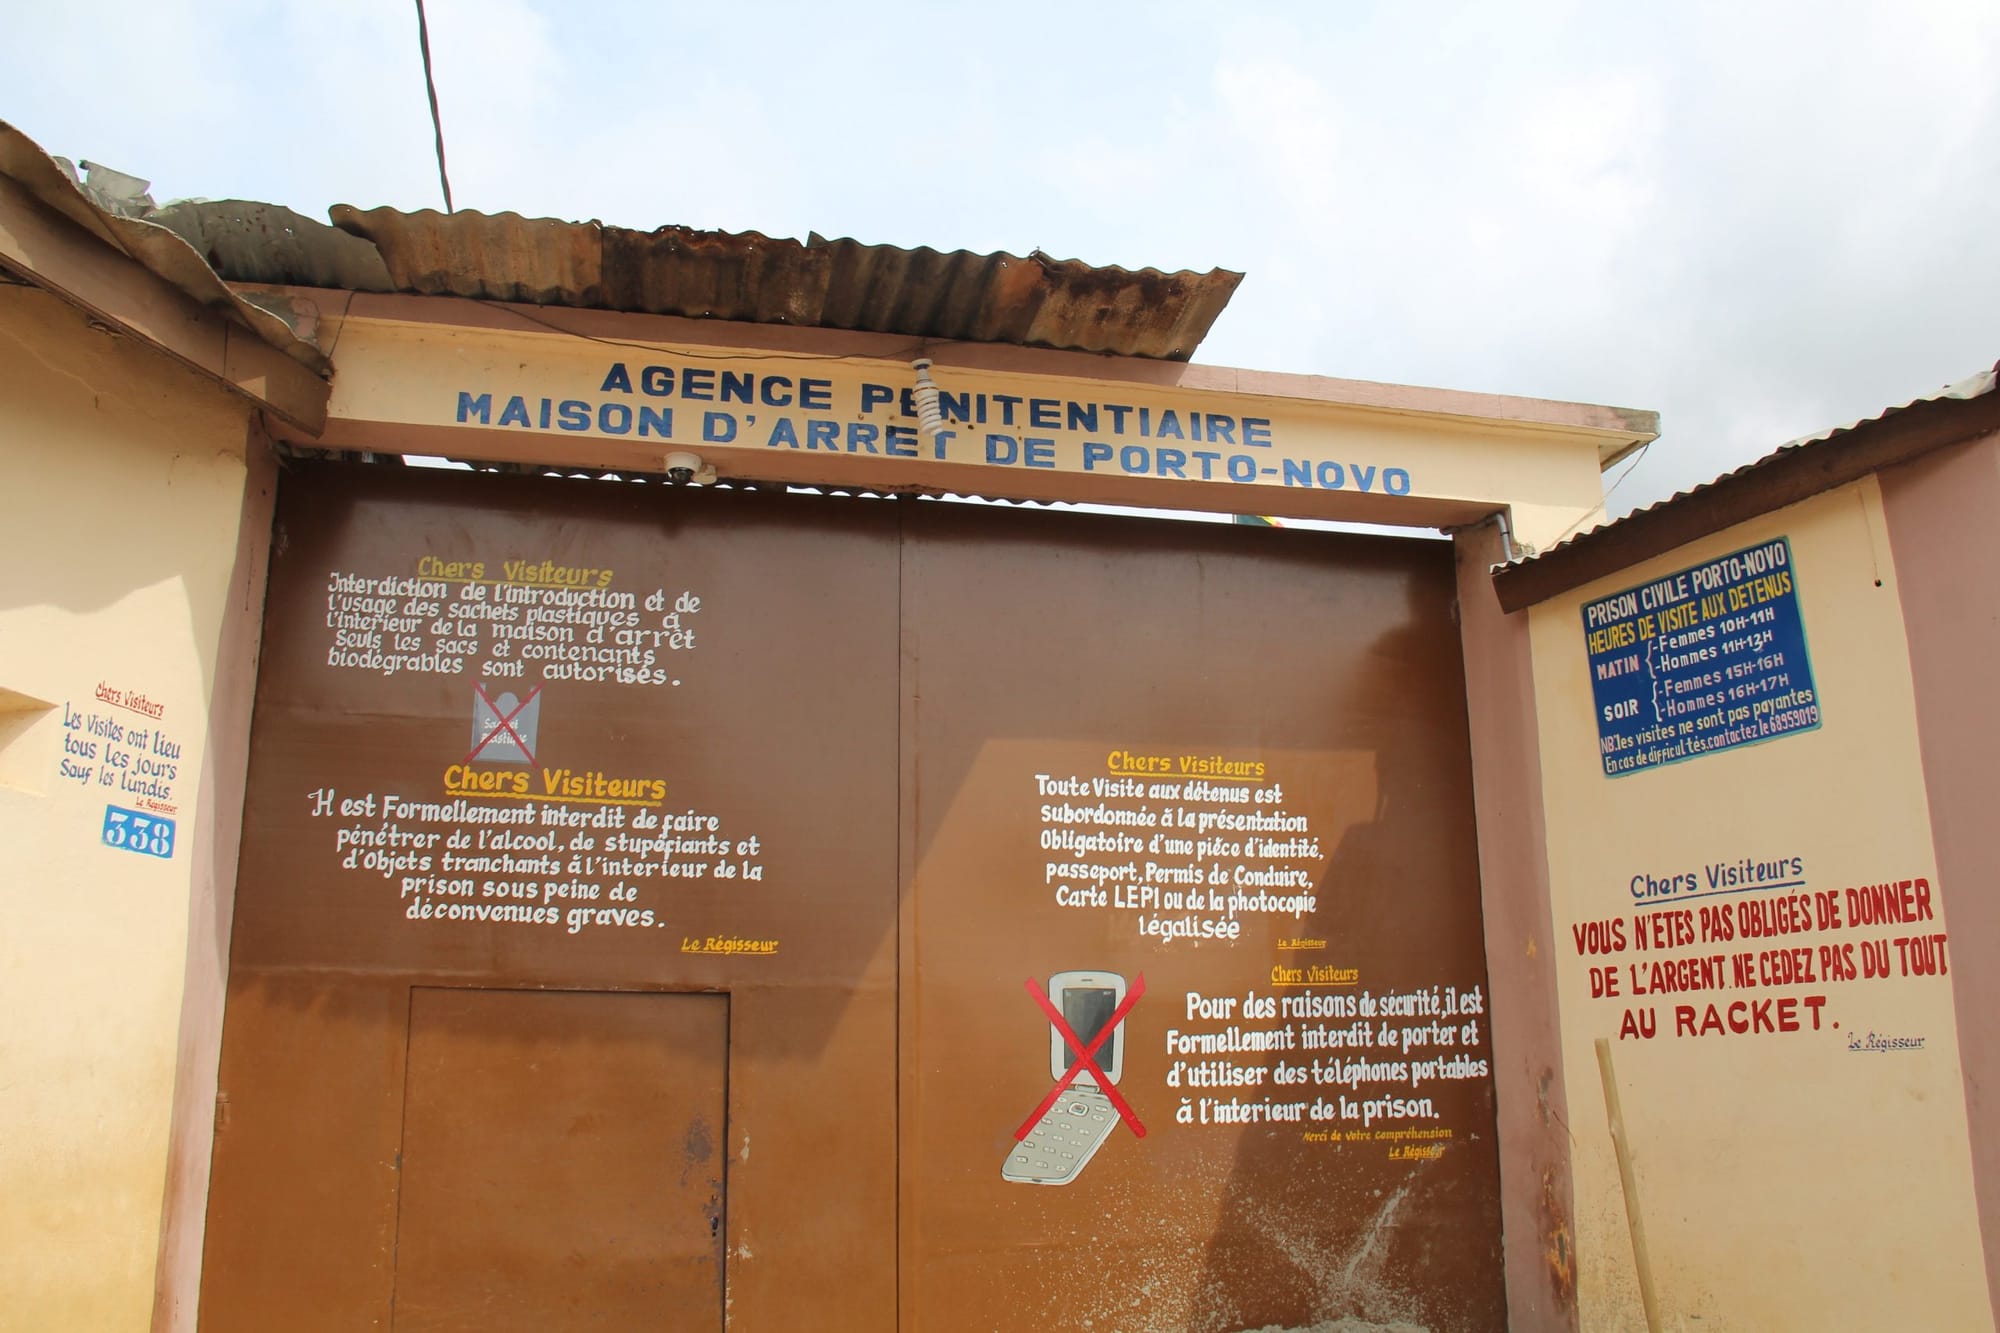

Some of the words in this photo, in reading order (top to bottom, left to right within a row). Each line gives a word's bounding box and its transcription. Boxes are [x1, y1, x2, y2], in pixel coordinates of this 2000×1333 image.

[601, 363, 832, 410] AGENCE
[861, 384, 1272, 448] PENITENTIAIRE
[457, 391, 673, 439] MAISON
[703, 411, 956, 460] D'ARRET
[985, 433, 1056, 468] DE
[1083, 442, 1411, 497] PORTO-NOVO
[418, 556, 485, 580] Chers
[503, 559, 614, 587] Visiteurs
[1587, 593, 1638, 628] PRISON
[1641, 575, 1689, 610] CIVILE
[1691, 542, 1786, 594] PORTO-NOVO
[328, 572, 447, 599] Interdiction
[461, 581, 486, 601] de
[494, 583, 635, 610] l'introduction
[644, 589, 665, 612] et
[675, 591, 701, 613] de
[328, 593, 396, 618] l'usage
[403, 600, 440, 617] des
[448, 601, 519, 621] sachets
[526, 606, 640, 628] plastiques
[1588, 622, 1637, 655] HEURES
[1638, 617, 1656, 641] DE
[1657, 601, 1698, 635] VISITE
[1702, 594, 1727, 621] AUX
[1729, 571, 1792, 612] DETENUS
[1719, 607, 1775, 634] 10H-11H
[327, 611, 422, 633] l'interieur
[430, 619, 453, 635] de
[457, 620, 478, 637] la
[492, 622, 574, 643] maison
[586, 625, 697, 650] d'arrêt
[336, 629, 382, 649] Seuls
[394, 634, 421, 651] les
[435, 638, 478, 655] sacs
[492, 639, 511, 657] et
[521, 642, 656, 666] contenants
[481, 658, 525, 677] sont
[1597, 654, 1640, 680] MATIN
[1725, 652, 1784, 680] 15H-16H
[1728, 673, 1789, 700] 16H-17H
[1604, 698, 1639, 721] SOIR
[1636, 723, 1676, 745] visites
[1678, 720, 1694, 735] ne
[1696, 707, 1726, 730] sont
[1728, 705, 1750, 727] pas
[1753, 688, 1813, 721] payantes
[1769, 705, 1819, 733] 68959019
[63, 700, 82, 730] Les
[127, 728, 149, 750] ont
[153, 730, 182, 760] lieu
[64, 732, 97, 759] tous
[105, 743, 130, 769] les
[131, 753, 178, 780] jours
[1107, 751, 1172, 771] Chers
[1179, 755, 1265, 776] Visiteurs
[98, 764, 114, 786] les
[443, 765, 529, 794] Chers
[543, 768, 667, 799] Visiteurs
[1035, 774, 1090, 796] Toute
[1092, 777, 1144, 798] Visite
[1148, 782, 1181, 800] aux
[1183, 780, 1250, 803] détenus
[1254, 783, 1283, 804] est
[106, 811, 170, 855] 338
[340, 793, 376, 817] est
[382, 795, 536, 824] Formellement
[541, 804, 625, 829] interdit
[632, 807, 658, 830] de
[661, 809, 720, 838] faire
[1040, 802, 1156, 827] subordonnée
[1178, 807, 1196, 828] la
[1198, 808, 1309, 834] présentation
[336, 822, 441, 852] pénétrer
[446, 828, 471, 849] de
[478, 828, 565, 853] l'alcool,
[569, 831, 595, 850] de
[605, 832, 731, 860] stupéfiants
[736, 833, 761, 855] et
[1040, 828, 1144, 858] Obligatoire
[1149, 833, 1194, 855] d'une
[1244, 836, 1325, 861] d'identité,
[342, 847, 433, 878] d'Objets
[441, 851, 561, 876] tranchants
[586, 857, 708, 878] l'interieur
[714, 859, 737, 879] de
[742, 860, 763, 881] la
[1046, 861, 1144, 887] passeport,
[1145, 861, 1204, 884] Permis
[1208, 862, 1229, 885] de
[1233, 864, 1313, 889] Conduire,
[1630, 869, 1698, 899] Chers
[1705, 856, 1804, 890] Visiteurs
[401, 874, 474, 898] prison
[482, 880, 539, 899] sous
[544, 878, 600, 904] peine
[609, 881, 638, 902] de
[1055, 884, 1108, 907] Carte
[1164, 891, 1183, 909] ou
[1186, 887, 1206, 910] de
[1209, 888, 1224, 911] la
[1227, 888, 1317, 920] photocopie
[406, 896, 560, 925] déconvenues
[567, 905, 666, 934] graves.
[1138, 913, 1241, 944] légalisée
[1572, 918, 1627, 956] VOUS
[1634, 909, 1694, 951] N'ETES
[1700, 902, 1735, 944] PAS
[1737, 888, 1811, 940] OBLIGÉS
[1815, 889, 1843, 932] DE
[1844, 877, 1934, 929] DONNER
[681, 937, 700, 952] Le
[703, 935, 779, 955] Régisseur
[1271, 964, 1302, 982] Chers
[1307, 964, 1359, 982] Visiteurs
[1589, 965, 1620, 999] DE
[1759, 947, 1817, 987] CEDEZ
[1819, 940, 1857, 982] PAS
[1861, 938, 1890, 979] DU
[1893, 933, 1948, 976] TOUT
[1186, 992, 1237, 1021] Pour
[1243, 990, 1277, 1019] des
[1281, 989, 1357, 1019] raisons
[1359, 990, 1378, 1018] de
[1460, 985, 1484, 1015] est
[1619, 1007, 1656, 1041] AU
[1675, 995, 1840, 1038] RACKET.
[1166, 1023, 1296, 1055] Formellement
[1302, 1021, 1374, 1050] interdit
[1377, 1021, 1399, 1047] de
[1401, 1019, 1457, 1055] porter
[1461, 1019, 1479, 1046] et
[1166, 1060, 1268, 1088] d'utiliser
[1273, 1059, 1308, 1085] des
[1311, 1055, 1409, 1091] téléphones
[1411, 1053, 1489, 1089] portables
[1199, 1097, 1307, 1125] l'interieur
[1310, 1096, 1336, 1120] de
[1339, 1095, 1360, 1119] la
[1363, 1093, 1440, 1127] prison.
